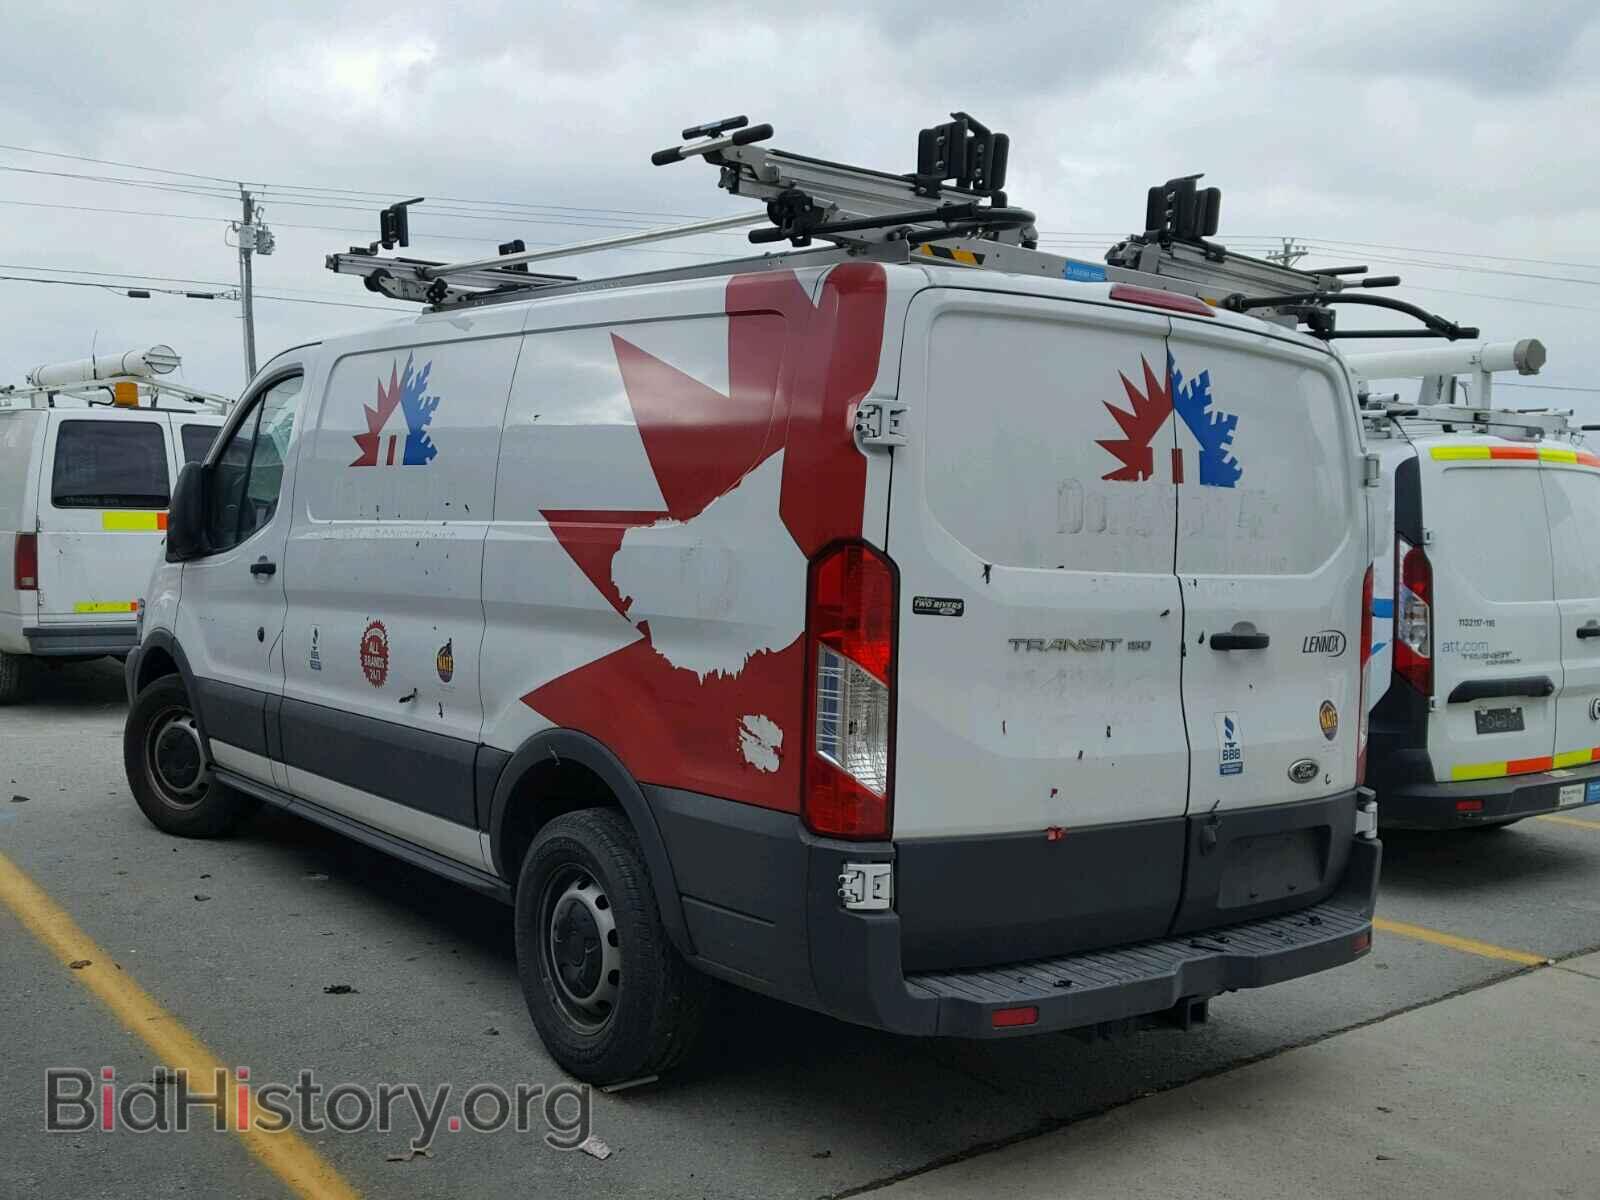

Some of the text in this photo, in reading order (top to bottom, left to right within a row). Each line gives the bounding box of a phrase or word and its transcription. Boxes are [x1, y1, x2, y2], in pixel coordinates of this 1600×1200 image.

[914, 599, 962, 609] TWO RIVERS
[368, 641, 380, 655] ALL
[1008, 638, 1122, 652] TRANSIT
[1302, 633, 1341, 654] LENNOX
[1441, 640, 1489, 653] att.com
[1222, 748, 1240, 760] BBB
